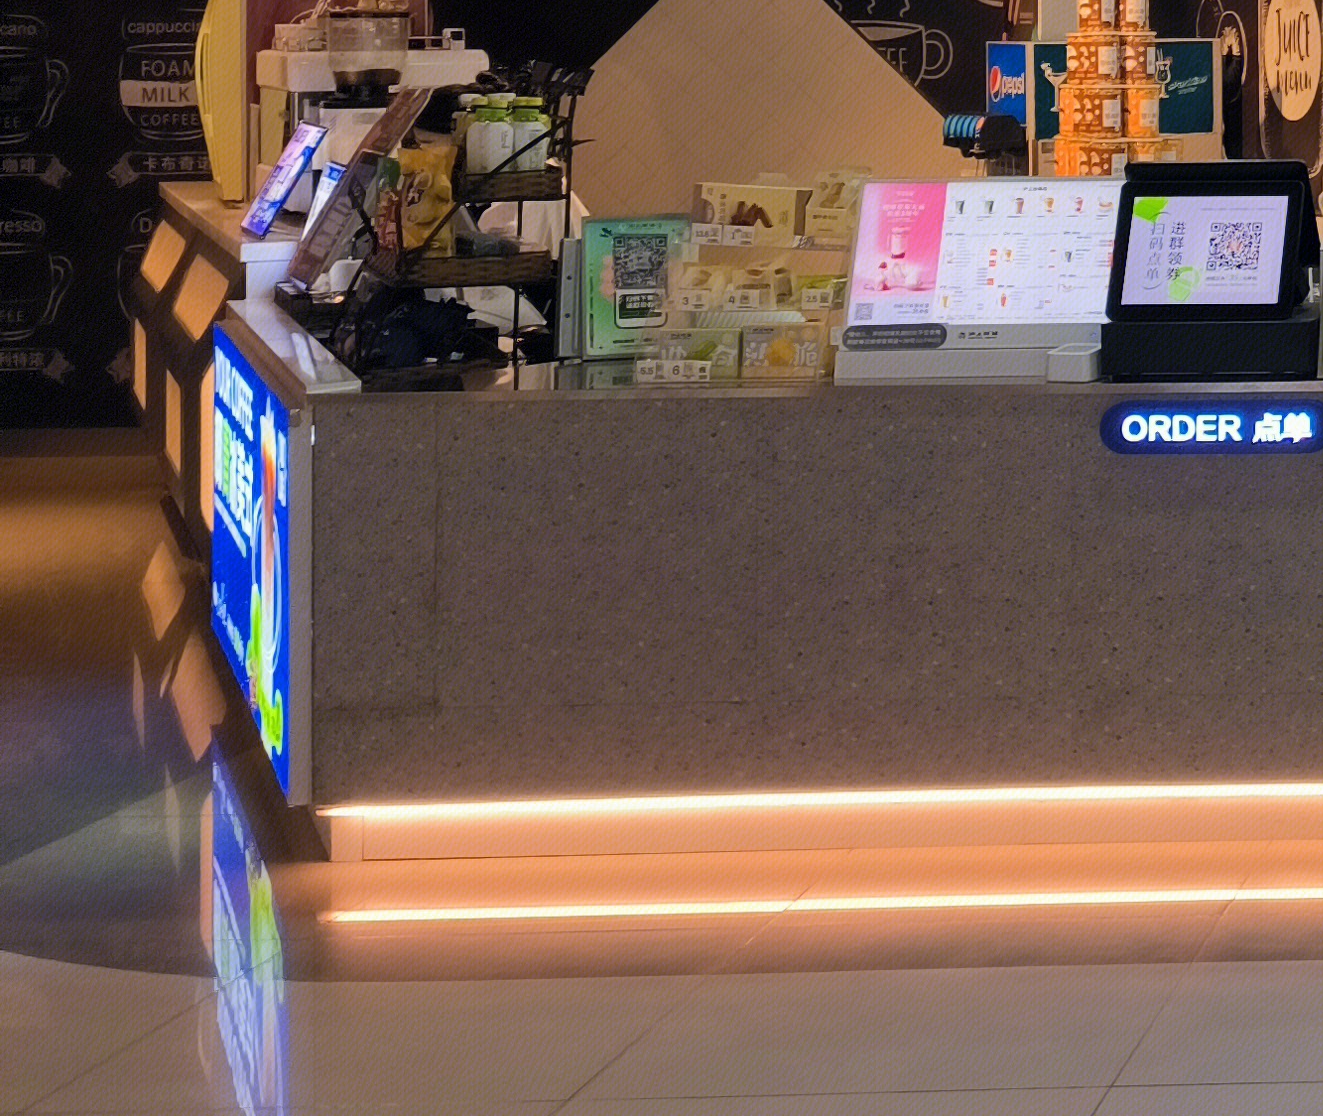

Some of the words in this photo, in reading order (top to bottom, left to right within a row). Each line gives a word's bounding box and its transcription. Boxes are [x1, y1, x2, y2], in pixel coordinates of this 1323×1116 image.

[141, 87, 190, 103] MILK
[1001, 72, 1025, 99] pepsi
[672, 365, 681, 376] 6
[1121, 414, 1243, 443] ORDER
[1251, 411, 1314, 444] 点单
